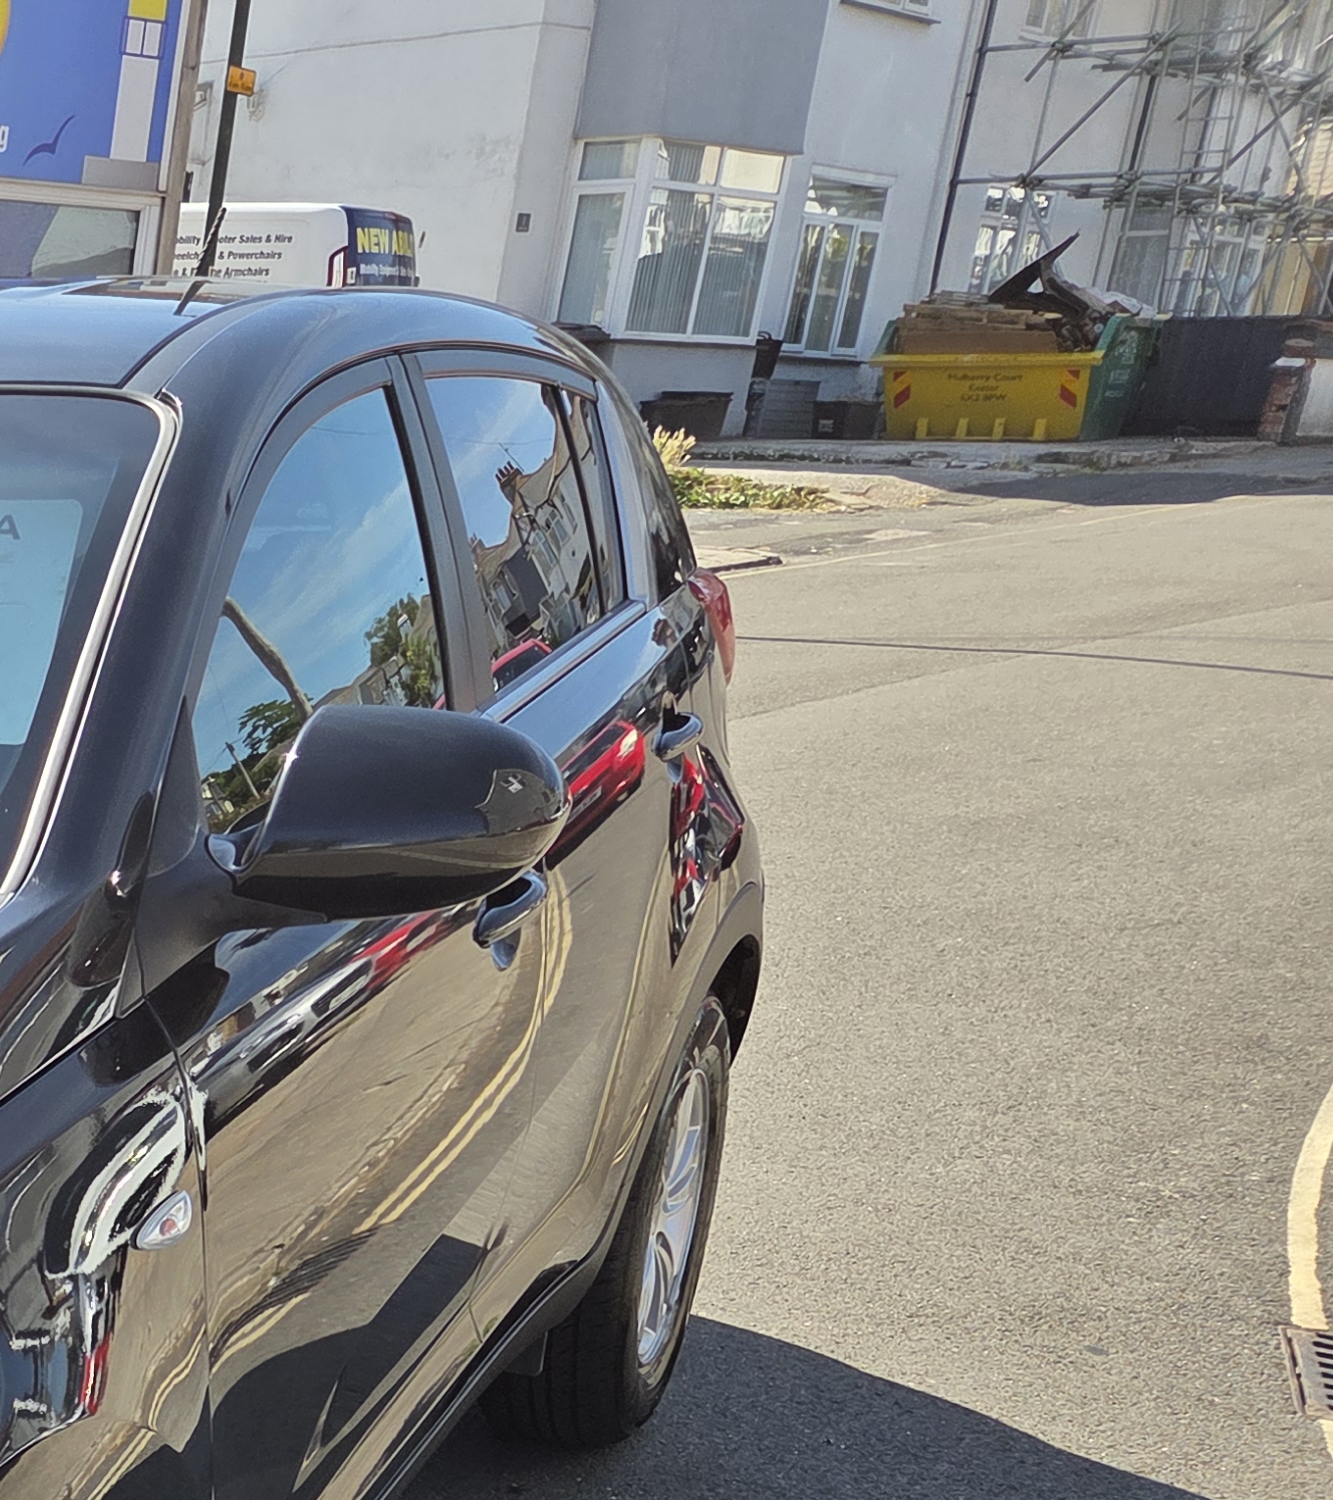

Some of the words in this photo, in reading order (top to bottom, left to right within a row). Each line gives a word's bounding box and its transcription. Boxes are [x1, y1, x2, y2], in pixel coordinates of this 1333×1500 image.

[239, 234, 263, 244] Sales
[274, 234, 293, 244] Hire
[357, 227, 389, 254] NEW
[227, 250, 282, 260] Powerchairs
[223, 266, 270, 278] Armchairs
